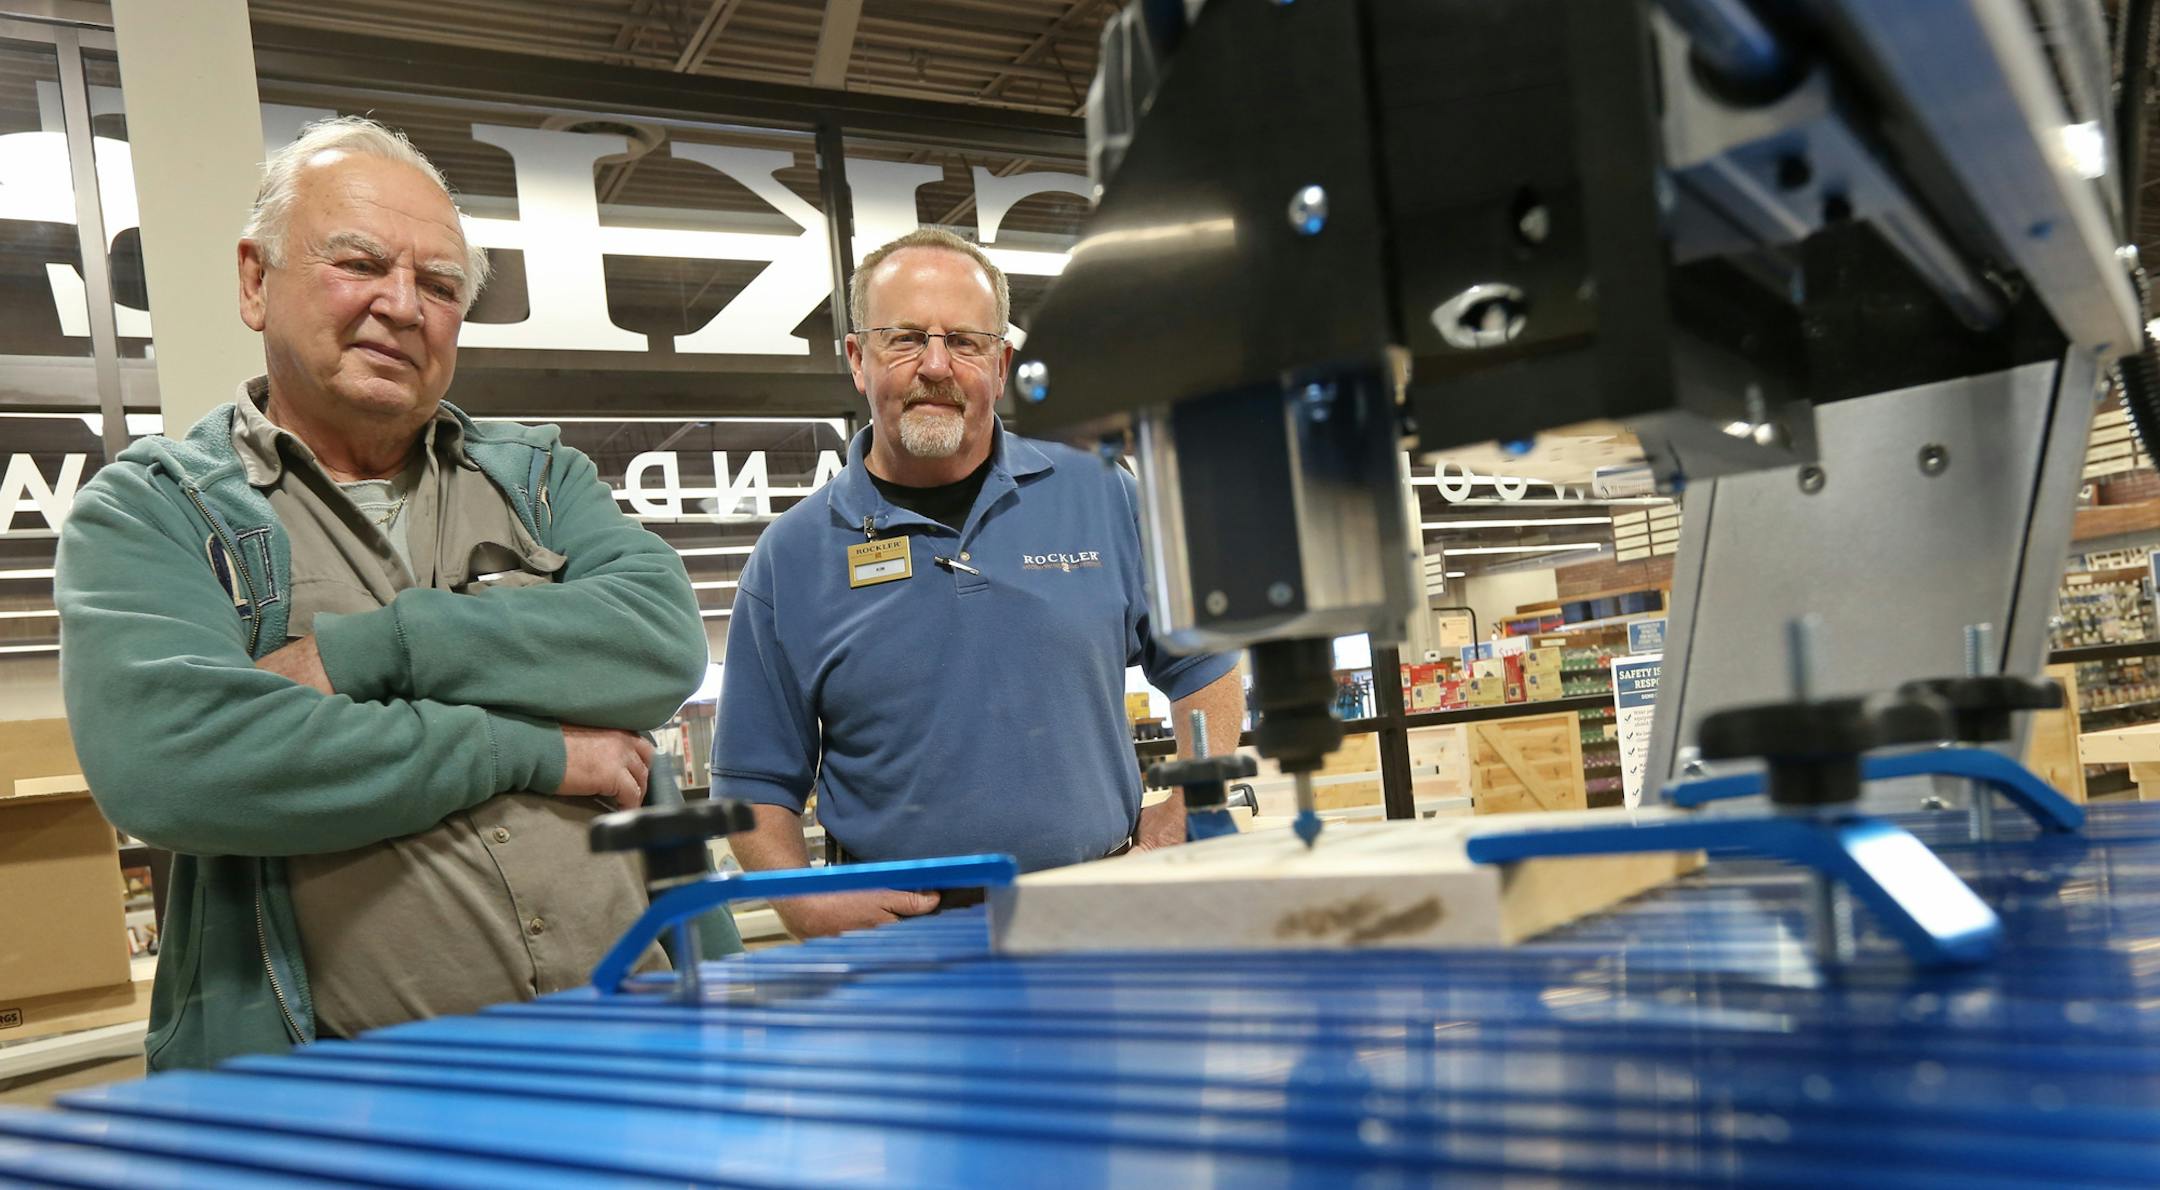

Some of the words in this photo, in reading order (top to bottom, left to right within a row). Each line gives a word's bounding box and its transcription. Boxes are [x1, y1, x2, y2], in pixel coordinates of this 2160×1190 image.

[856, 542, 900, 554] ROCKLER
[1023, 551, 1098, 565] ROCKLER
[1619, 668, 1651, 680] SAFETY
